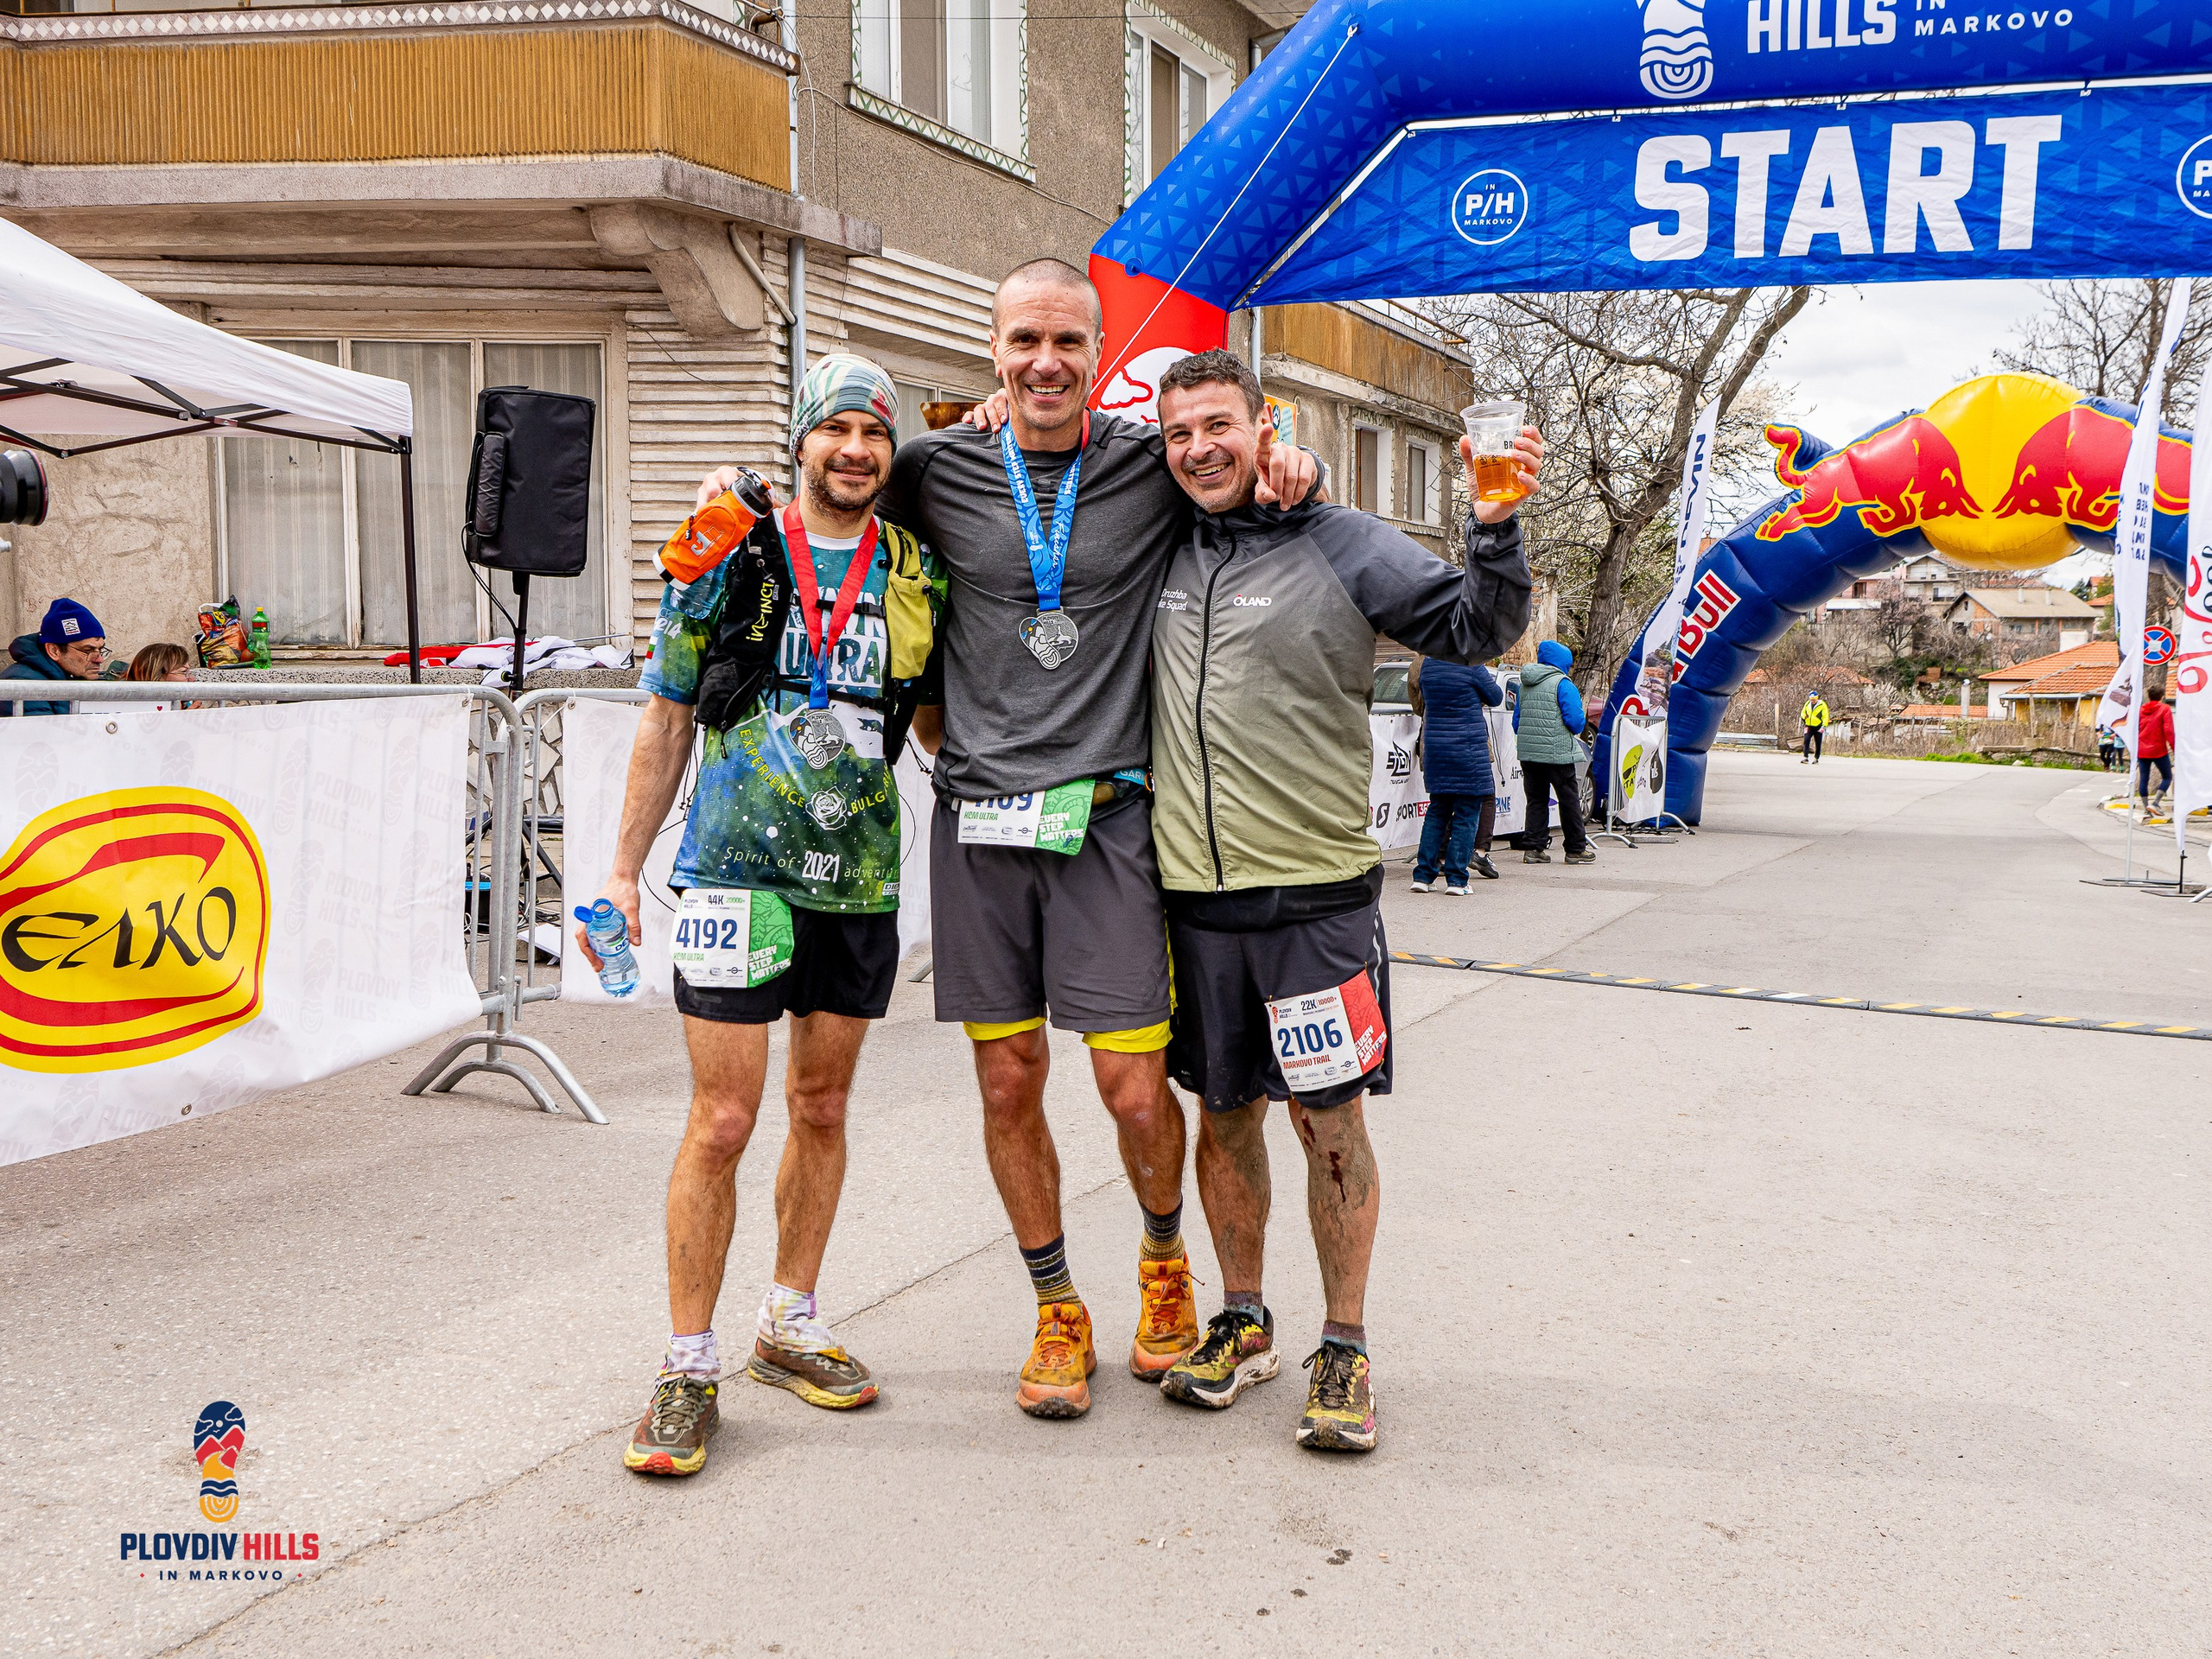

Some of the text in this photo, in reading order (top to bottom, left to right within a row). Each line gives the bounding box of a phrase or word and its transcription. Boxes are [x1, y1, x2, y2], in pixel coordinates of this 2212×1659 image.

[1747, 0, 1897, 54] HILLS
[1915, 9, 2074, 36] MARKOVO
[1628, 114, 2062, 263] START
[1465, 192, 1515, 218] P/H
[1678, 572, 1738, 656] Bull
[740, 728, 806, 809] EXPERIENCE
[1039, 822, 1065, 833] STEP
[724, 846, 797, 869] Spirit of
[802, 849, 841, 884] 2021
[676, 918, 738, 950] 4192
[1300, 999, 1318, 1012] 22K
[1277, 1018, 1343, 1058] 2106
[1282, 1054, 1332, 1070] MARKOVO TRAIL
